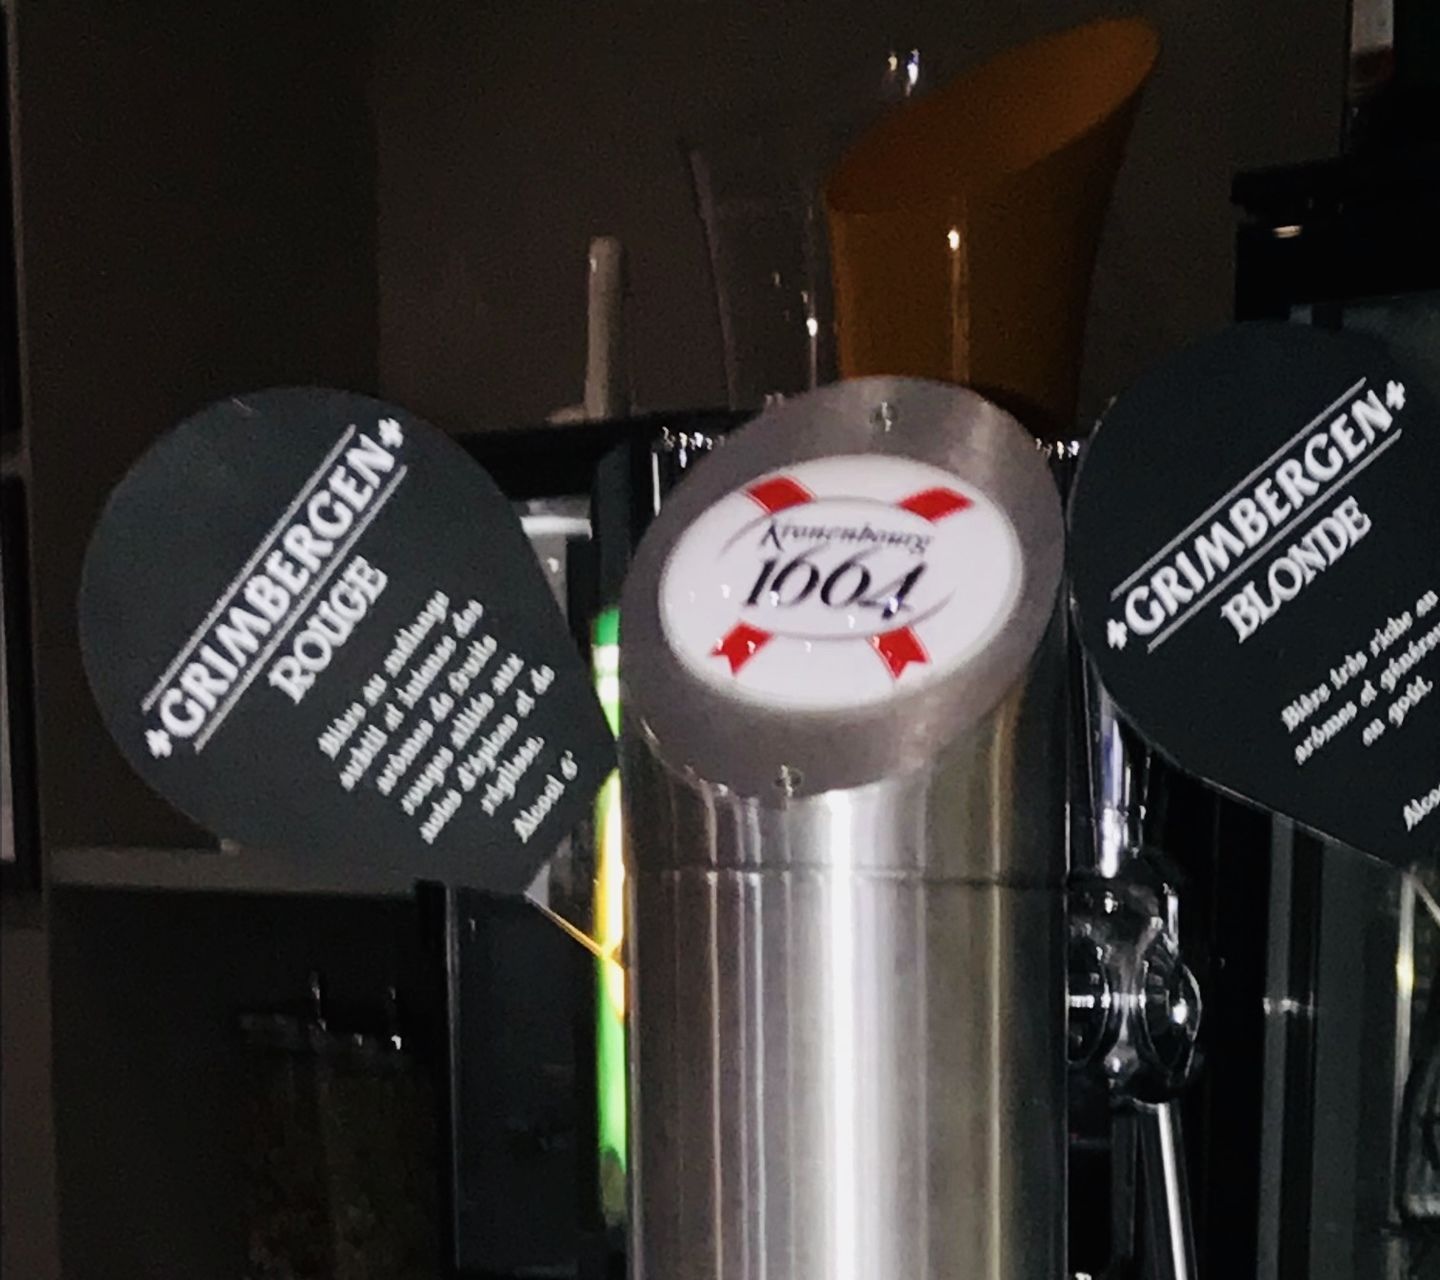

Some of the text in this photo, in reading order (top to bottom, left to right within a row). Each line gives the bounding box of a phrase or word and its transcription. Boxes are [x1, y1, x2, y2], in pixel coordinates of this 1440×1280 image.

[759, 519, 934, 555] Kronenbourg
[1124, 389, 1393, 634] GRIMBERGEN
[159, 429, 396, 747] GRIMBERGEN
[744, 543, 928, 620] 1664
[1220, 495, 1372, 644] BLONDE
[267, 555, 388, 705] ROUGE
[1369, 611, 1413, 658] riche
[1416, 590, 1439, 617] au
[362, 673, 388, 707] au
[384, 702, 405, 732] et
[451, 599, 484, 639] des
[1360, 679, 1378, 707] et
[400, 746, 454, 816] rouges
[491, 652, 525, 696] aux
[428, 692, 455, 723] de
[1362, 718, 1386, 746] au
[419, 788, 463, 845] notes
[515, 688, 535, 718] et
[530, 664, 555, 695] de
[512, 774, 566, 844] Alcool
